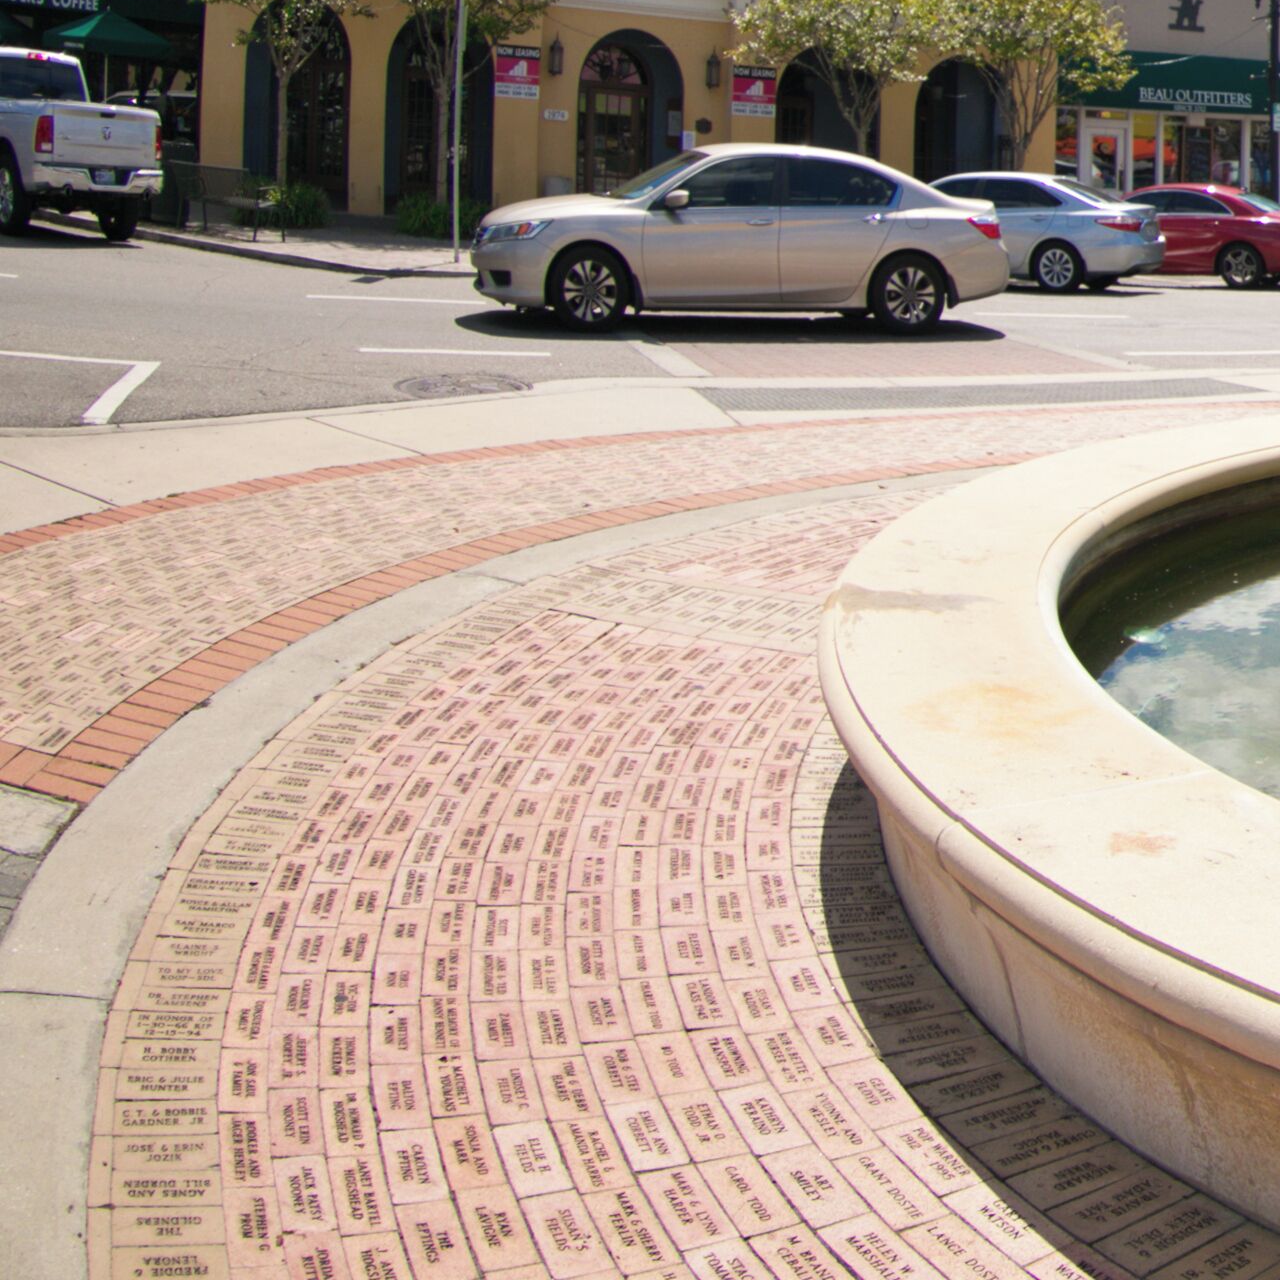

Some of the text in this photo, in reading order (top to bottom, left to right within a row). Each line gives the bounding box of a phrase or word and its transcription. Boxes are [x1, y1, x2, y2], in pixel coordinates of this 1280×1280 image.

[497, 47, 540, 57] NOW LEASING
[734, 67, 776, 78] NOW LEASING
[1139, 87, 1252, 105] BEAU OUTFITTERS
[182, 926, 223, 934] PETITES
[200, 921, 236, 929] MARCO
[145, 1029, 201, 1037] 12-15-94
[156, 1014, 194, 1022] HONOR
[447, 1008, 459, 1036] MEMORY
[486, 1018, 500, 1042] FAMILY
[550, 1008, 568, 1046] LAWRENCE
[450, 1039, 461, 1048] OF
[817, 1025, 835, 1045] WARD
[603, 1055, 624, 1088] CORBETT
[707, 1036, 737, 1078] TRANSPORT
[722, 1037, 750, 1074] BROWNING
[127, 1075, 154, 1083] ERIC
[232, 1071, 244, 1097] FAMILY
[401, 1079, 415, 1111] DALTON
[497, 1077, 513, 1105] FIELDS
[551, 1074, 570, 1102] HARRIS
[562, 1061, 577, 1077] TOM
[571, 1088, 590, 1113] DEBBY
[854, 1080, 881, 1107] FLOYD
[296, 1097, 309, 1121] SCOTT
[387, 1082, 401, 1110] EPTING
[283, 1104, 296, 1138] NOONEY
[740, 1101, 772, 1136] PERAINO
[754, 1097, 788, 1135] KATHRYN
[808, 1105, 841, 1138] WESLEY
[815, 1091, 863, 1146] YVONNE AND
[246, 1120, 261, 1178] BOOKER AND
[588, 1130, 611, 1163] RACHEL
[626, 1116, 653, 1153] CORBETT
[638, 1110, 672, 1156] EMILY ANN
[146, 1154, 182, 1162] JOZIK
[396, 1149, 414, 1182] EPTING
[411, 1143, 431, 1185] CAROLYN
[452, 1139, 470, 1165] MARK
[513, 1143, 536, 1174] FIELDS
[568, 1122, 605, 1188] AMANDA HARRIS
[912, 1126, 971, 1178] POP WARNER
[123, 1179, 211, 1188] BILL DURDEN
[127, 1189, 206, 1198] AGNES AND
[289, 1175, 306, 1214] NOONEY
[301, 1166, 324, 1222] JACK PATSY
[356, 1159, 382, 1226] JANET BARTEL
[724, 1165, 772, 1222] CAROL TODD
[790, 1170, 825, 1202] SMILEY
[811, 1173, 835, 1191] ART
[858, 1156, 924, 1220] GRANT DOSTIE
[663, 1188, 694, 1226] HARPER
[670, 1171, 696, 1197] MARY
[695, 1210, 721, 1237] LYNN
[1075, 1178, 1155, 1221] ADAM TATE
[136, 1216, 202, 1226] GILDNERS
[157, 1227, 183, 1236] THE
[253, 1197, 269, 1240] STEPHEN
[475, 1206, 503, 1248] LAVIGNE
[494, 1211, 515, 1238] RYAN
[545, 1217, 571, 1252] FIELDS
[608, 1212, 637, 1247] FERLIN
[614, 1191, 638, 1218] MARK
[635, 1227, 665, 1263] SHERRY
[979, 1205, 1025, 1241] WATSON
[416, 1222, 440, 1264] EPTINGS
[436, 1230, 455, 1251] THE
[926, 1225, 968, 1257] LANCE
[134, 1266, 209, 1277] FREDDIE &
[143, 1255, 198, 1266] LENORA
